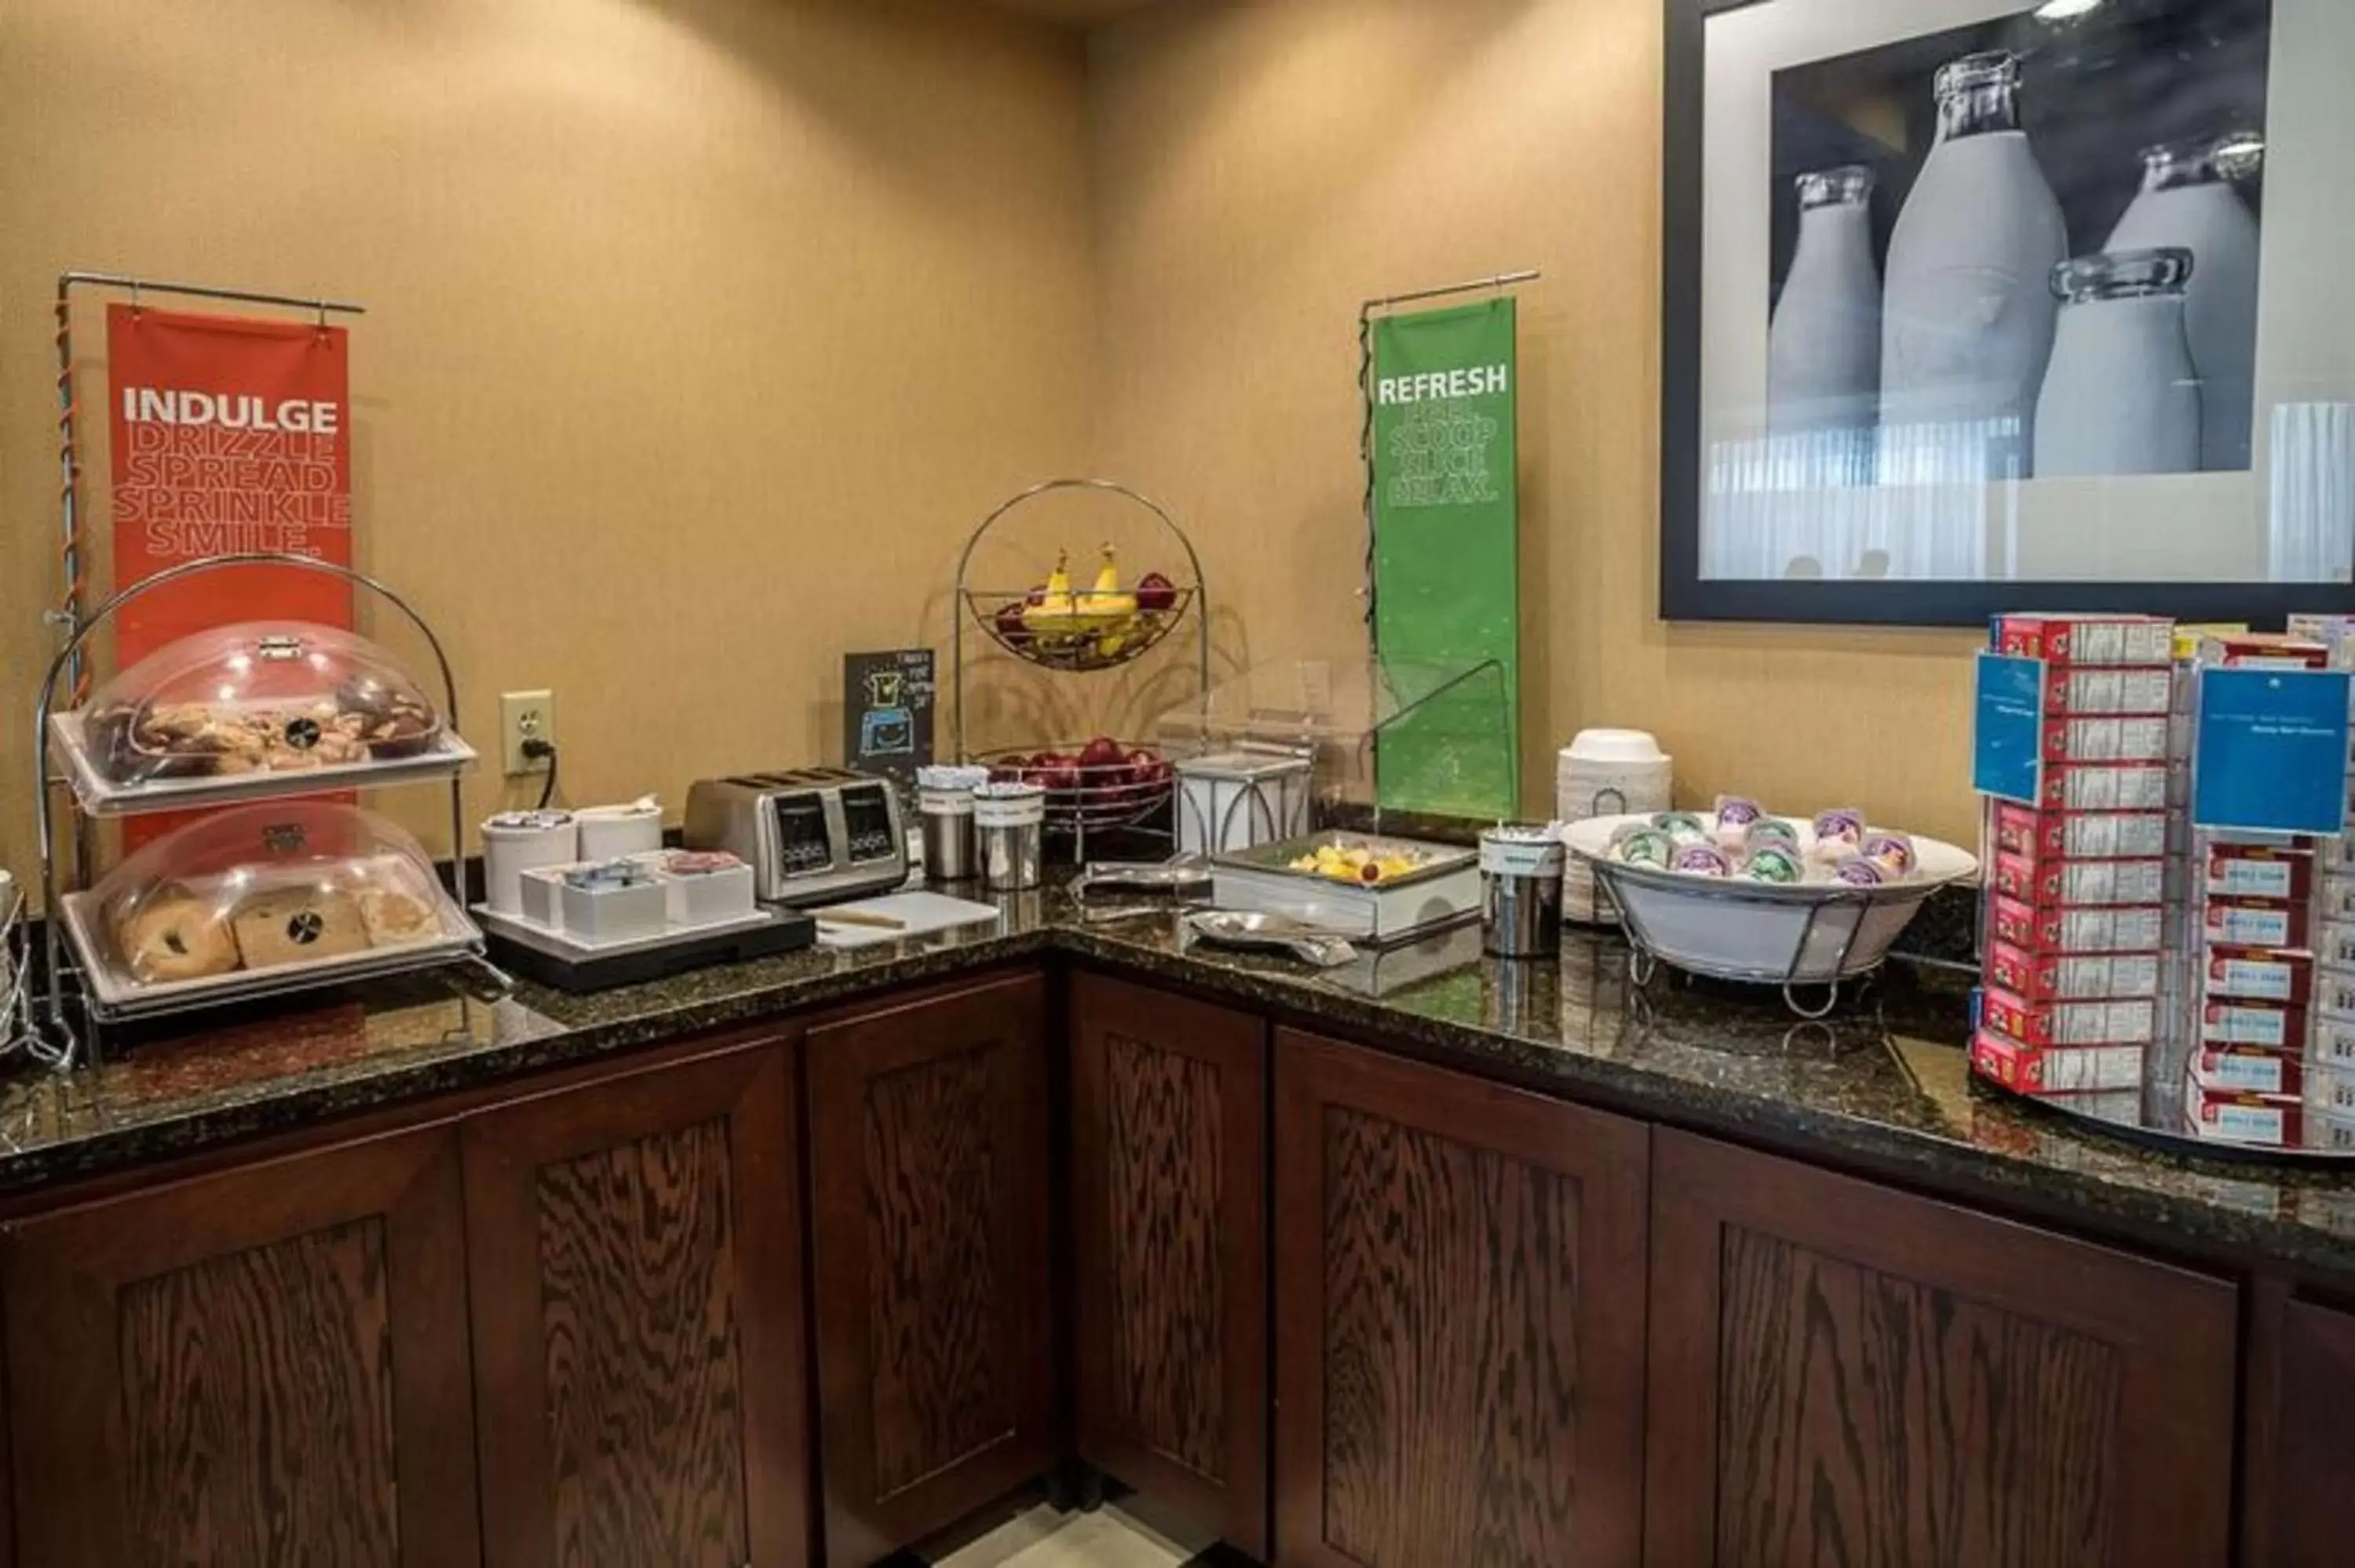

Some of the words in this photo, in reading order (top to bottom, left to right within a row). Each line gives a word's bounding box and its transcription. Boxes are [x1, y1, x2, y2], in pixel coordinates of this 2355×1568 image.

[1378, 363, 1507, 405] REFRESH
[122, 387, 338, 433] INDULGE
[128, 422, 336, 463] DRIZZLE
[127, 454, 337, 492] SPREAD
[114, 487, 352, 528] SPRINKLE
[146, 520, 322, 556] SMILE.
